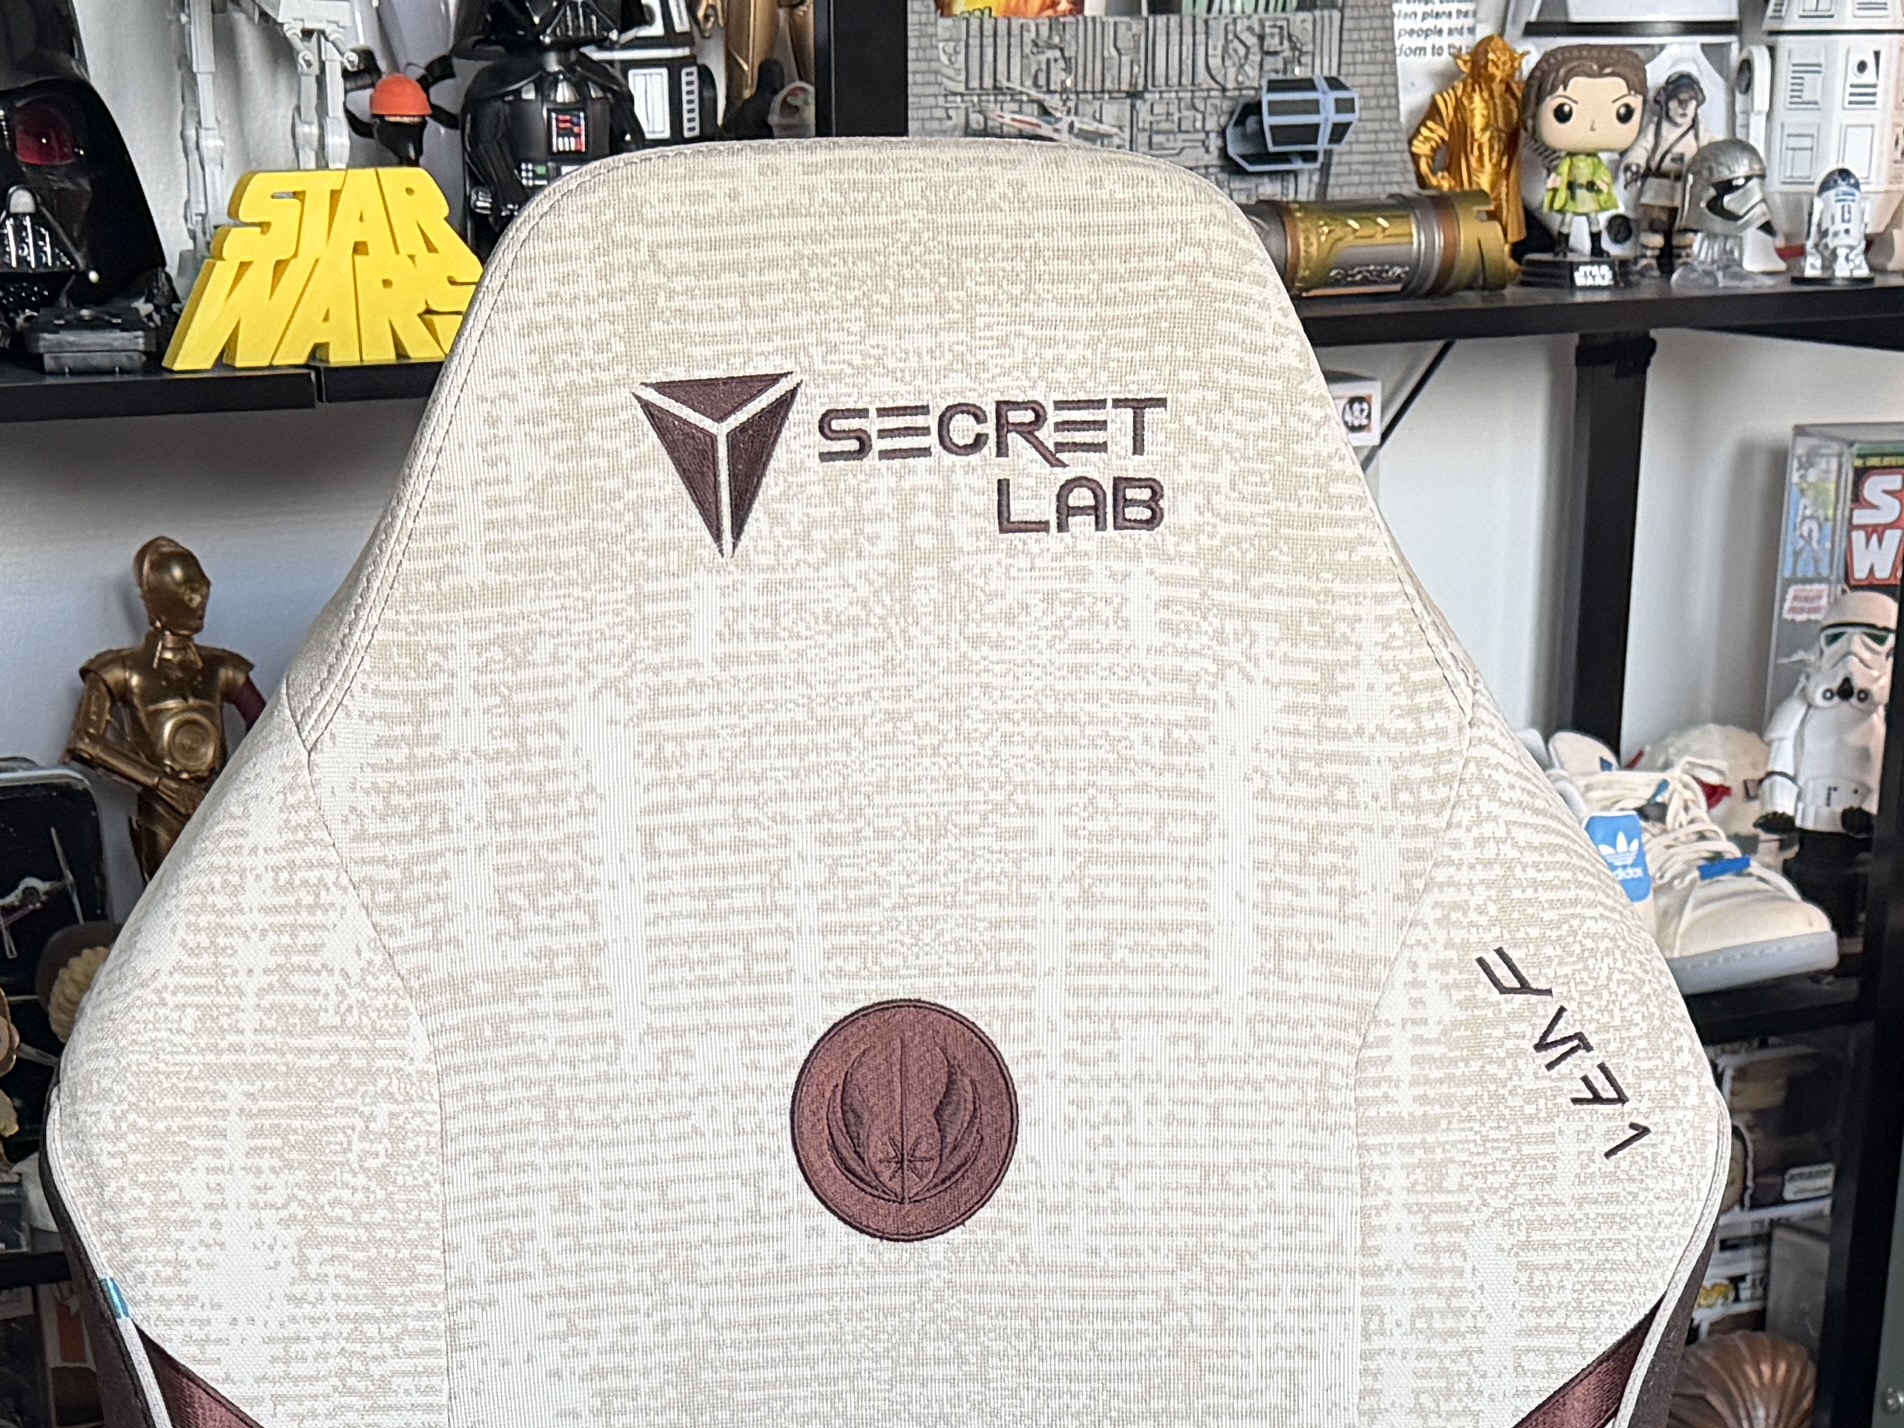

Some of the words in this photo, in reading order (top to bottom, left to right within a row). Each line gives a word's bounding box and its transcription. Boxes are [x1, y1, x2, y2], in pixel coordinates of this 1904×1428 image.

[213, 167, 466, 262] STAR
[161, 252, 481, 371] WARS
[819, 398, 1168, 468] SECRET
[996, 476, 1165, 535] LAB
